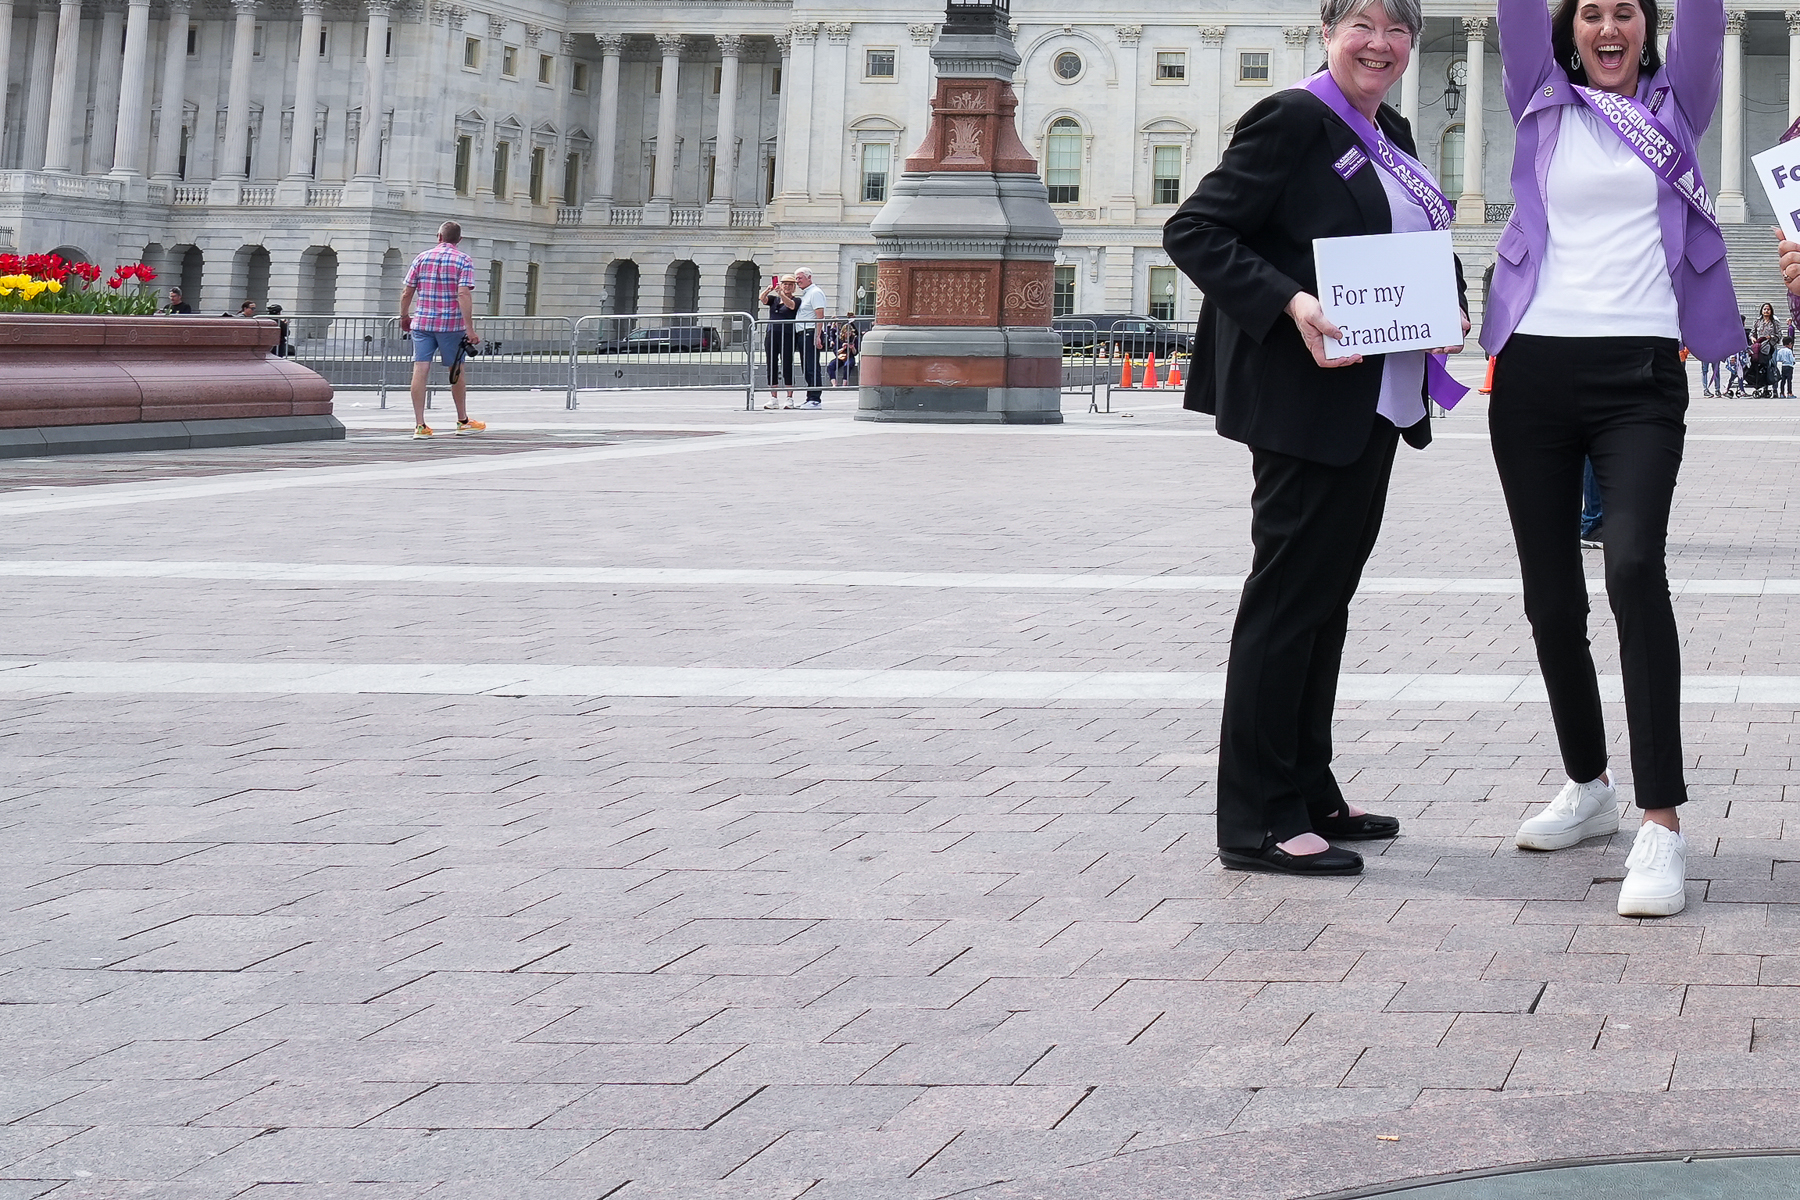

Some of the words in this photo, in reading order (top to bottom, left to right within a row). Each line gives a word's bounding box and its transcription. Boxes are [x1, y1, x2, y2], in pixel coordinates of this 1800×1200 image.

[1591, 93, 1667, 168] ASSOCIATION
[1392, 167, 1444, 230] ASSOCIATI
[1332, 284, 1367, 306] For
[1374, 285, 1405, 307] my
[1337, 320, 1431, 347] Grandma
